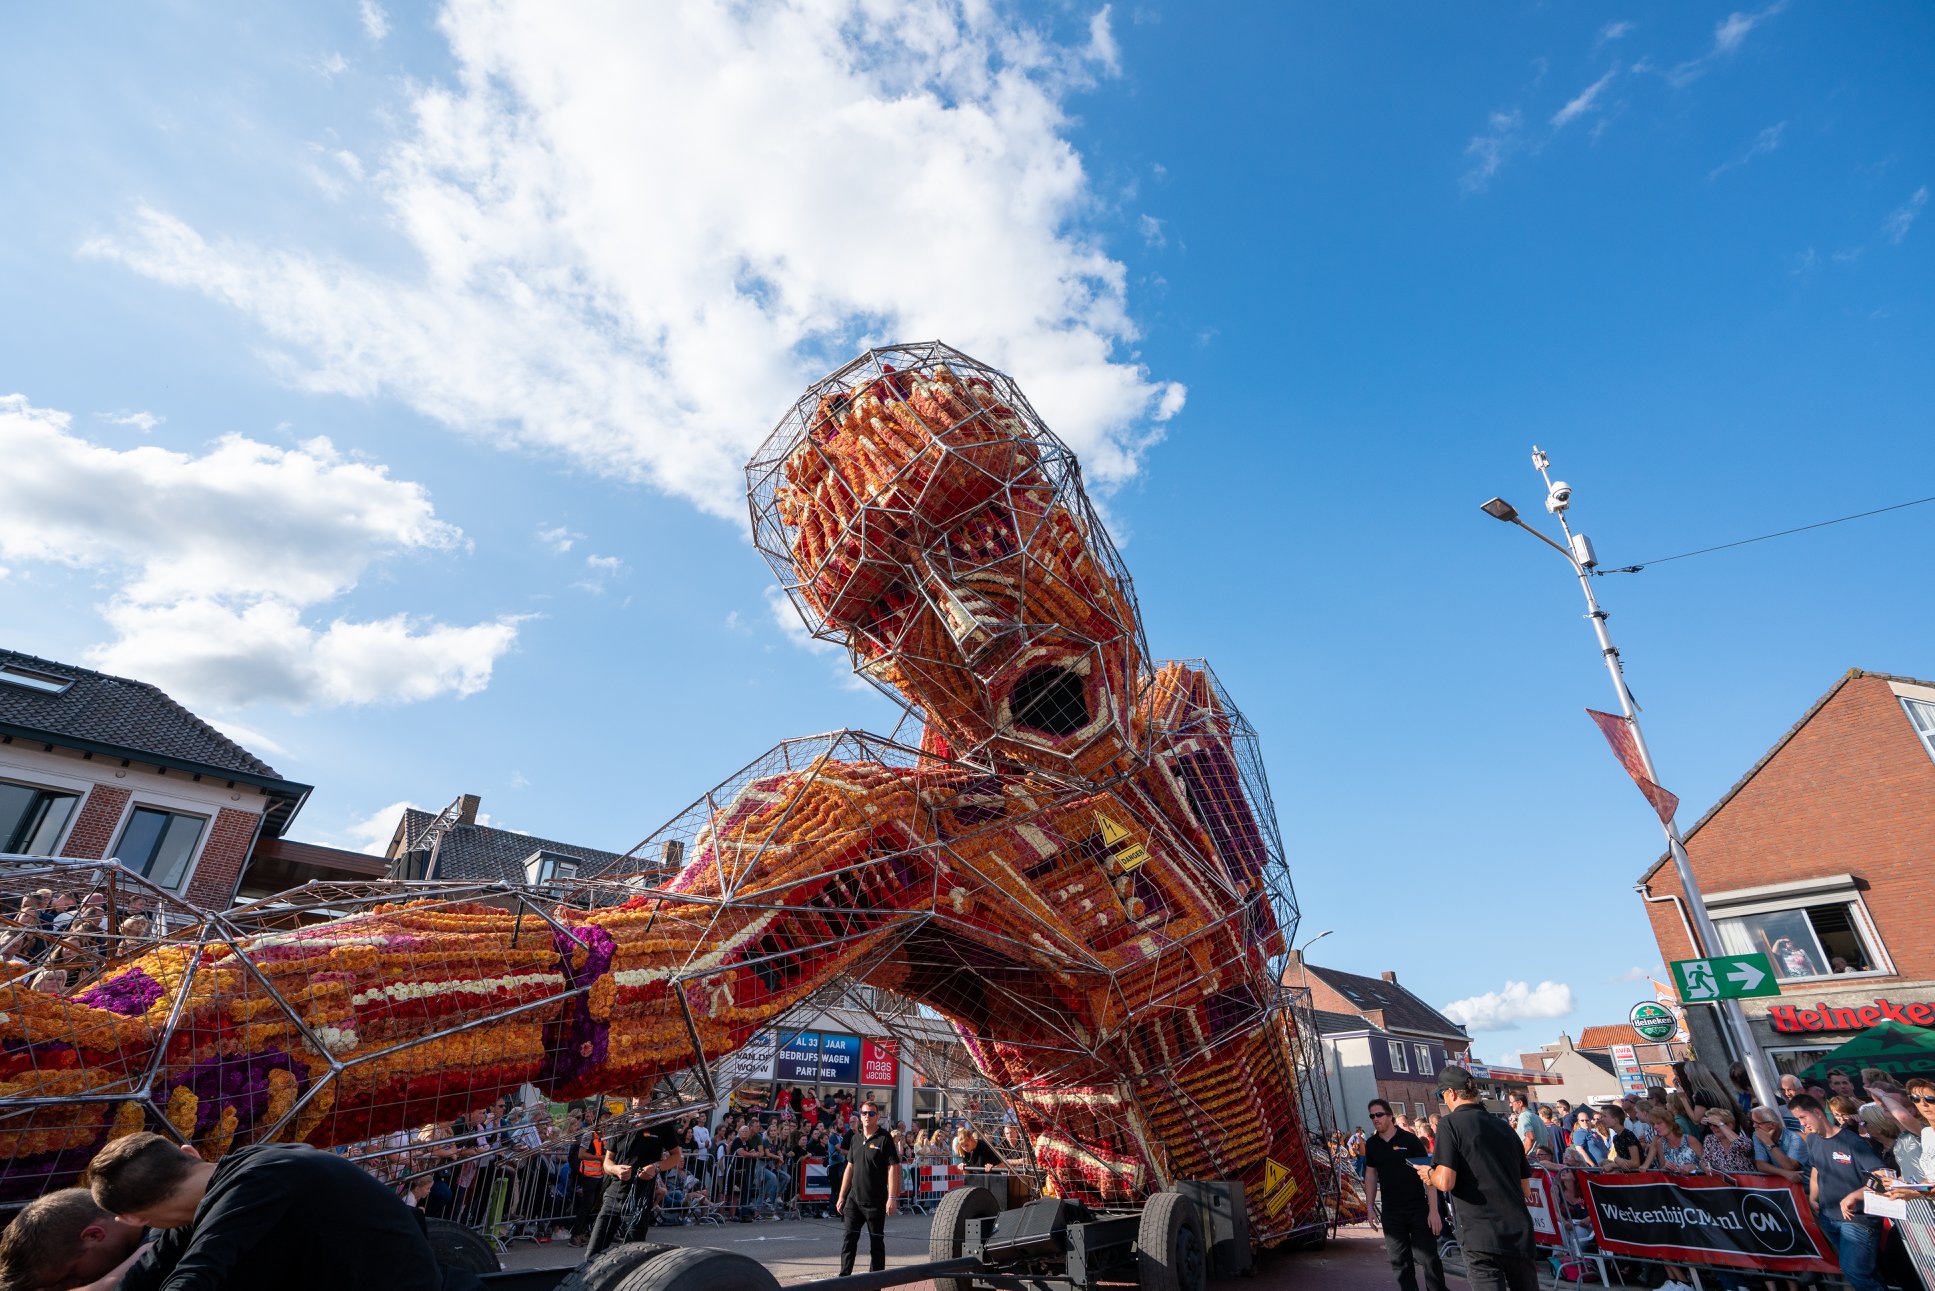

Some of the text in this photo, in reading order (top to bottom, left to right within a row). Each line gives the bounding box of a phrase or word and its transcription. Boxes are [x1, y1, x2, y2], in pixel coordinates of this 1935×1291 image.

[1121, 849, 1145, 865] DANGER
[1634, 1016, 1673, 1027] Heineken
[1768, 998, 1935, 1032] Heineke
[795, 1037, 846, 1050] AL 33 JAAR
[866, 1060, 892, 1072] maas
[1524, 1191, 1539, 1204] UT
